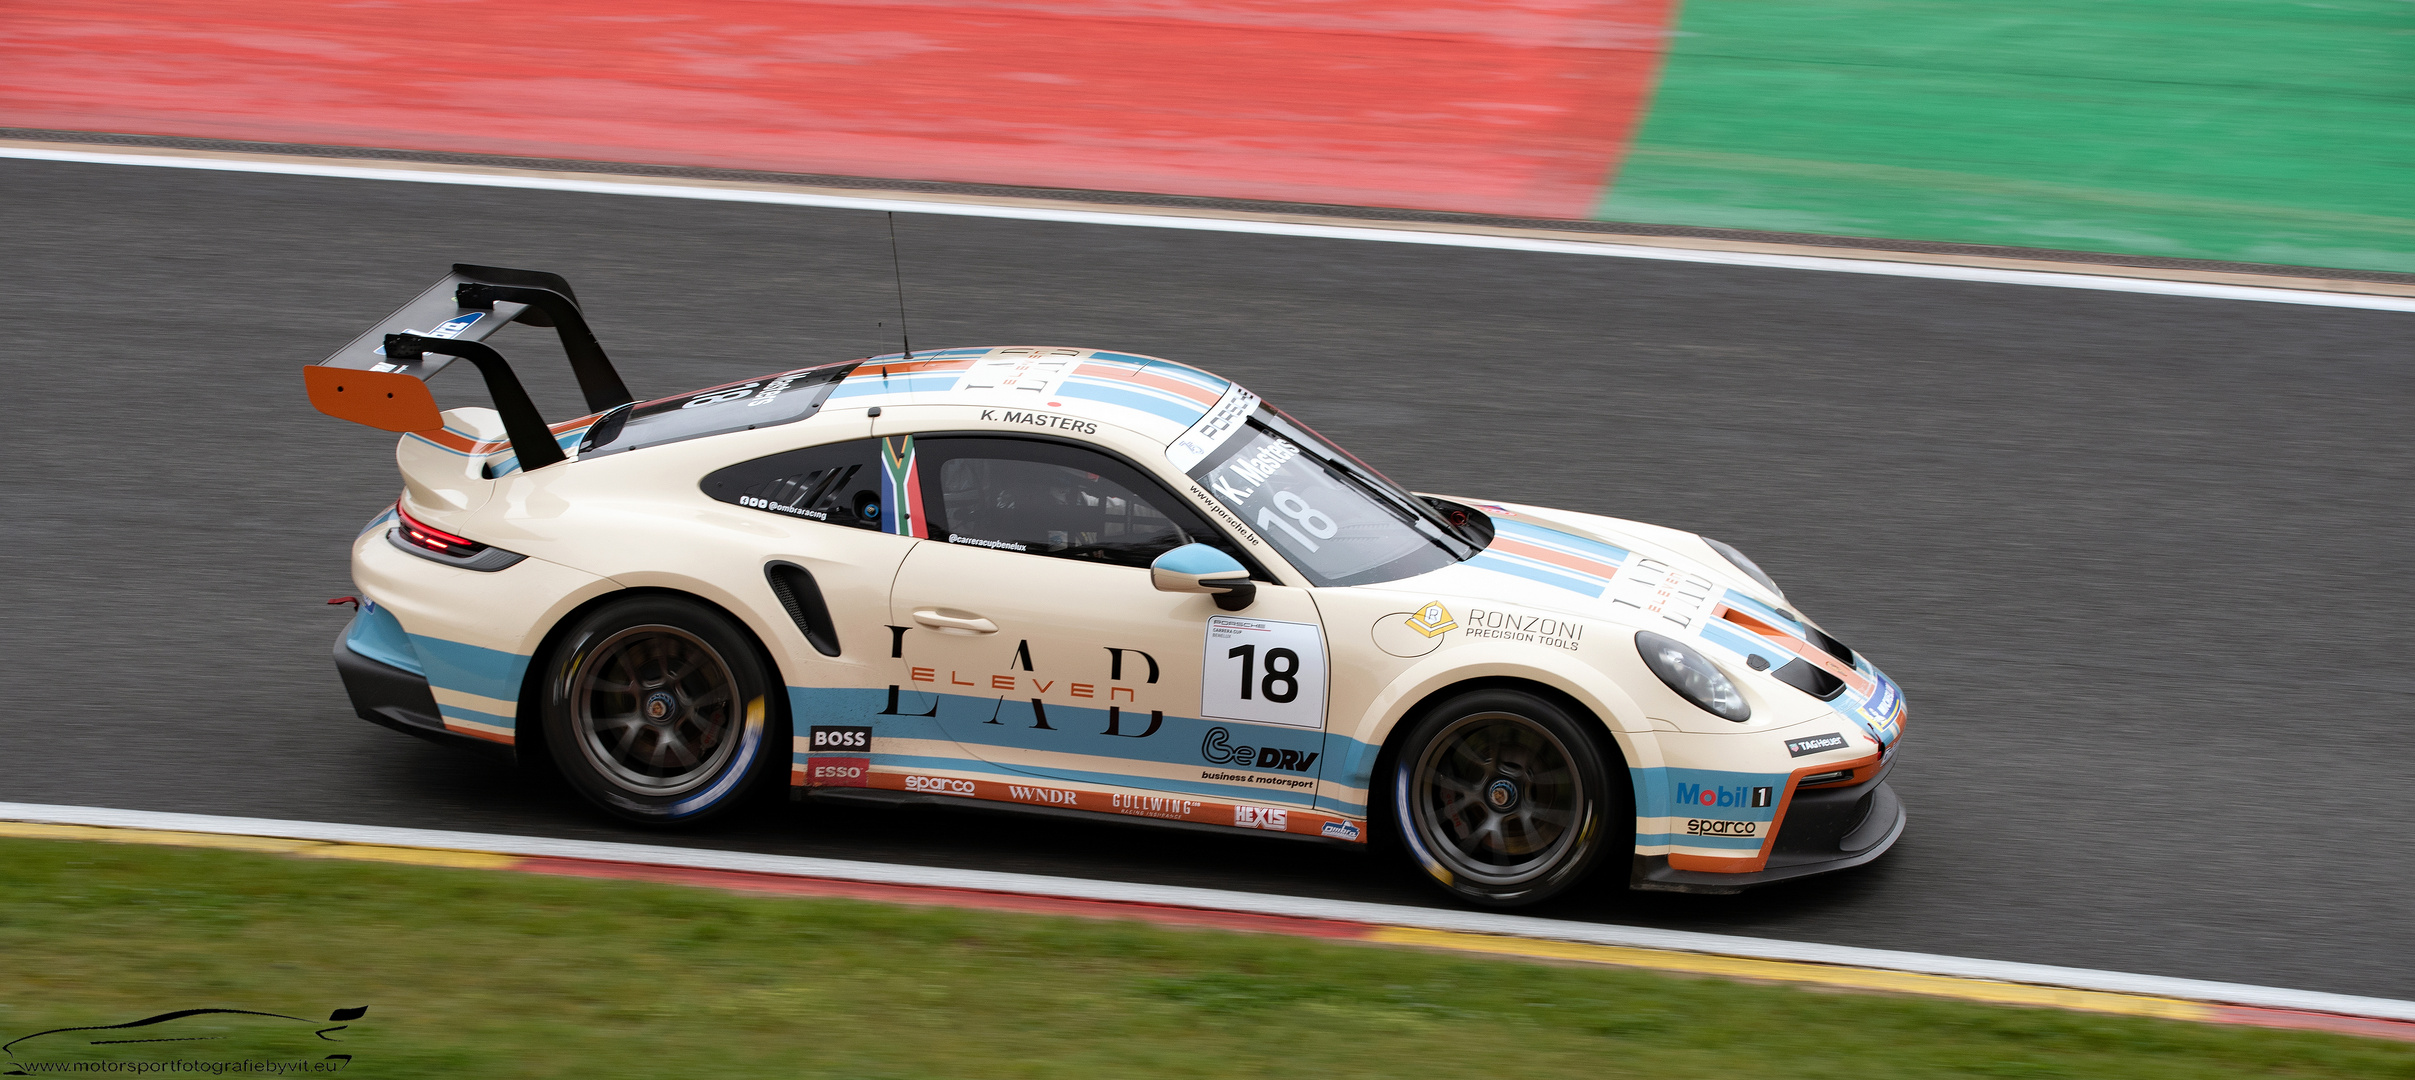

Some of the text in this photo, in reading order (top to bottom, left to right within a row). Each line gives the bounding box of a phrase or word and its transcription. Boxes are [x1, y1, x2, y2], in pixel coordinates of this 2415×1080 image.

[980, 409, 1098, 435] K. MASTERS
[1212, 438, 1300, 506] K. Masters
[1189, 485, 1259, 546] www.porsche.be
[1257, 490, 1338, 553] 18
[948, 533, 1026, 551] @carreracupbenelux
[1213, 619, 1265, 629] PORSCHE
[1468, 608, 1583, 641] RONZONI
[1466, 627, 1579, 651] PRECISION TOOLS
[1228, 644, 1299, 703] 18
[815, 731, 866, 747] BOSS
[815, 766, 861, 779] ESSO
[1201, 771, 1314, 789] business & motorsport
[904, 776, 976, 797] sparco
[1676, 783, 1748, 808] Mobil
[1112, 793, 1191, 815] GULLWING
[1236, 805, 1286, 830] HEXIS
[1687, 819, 1756, 837] sparco
